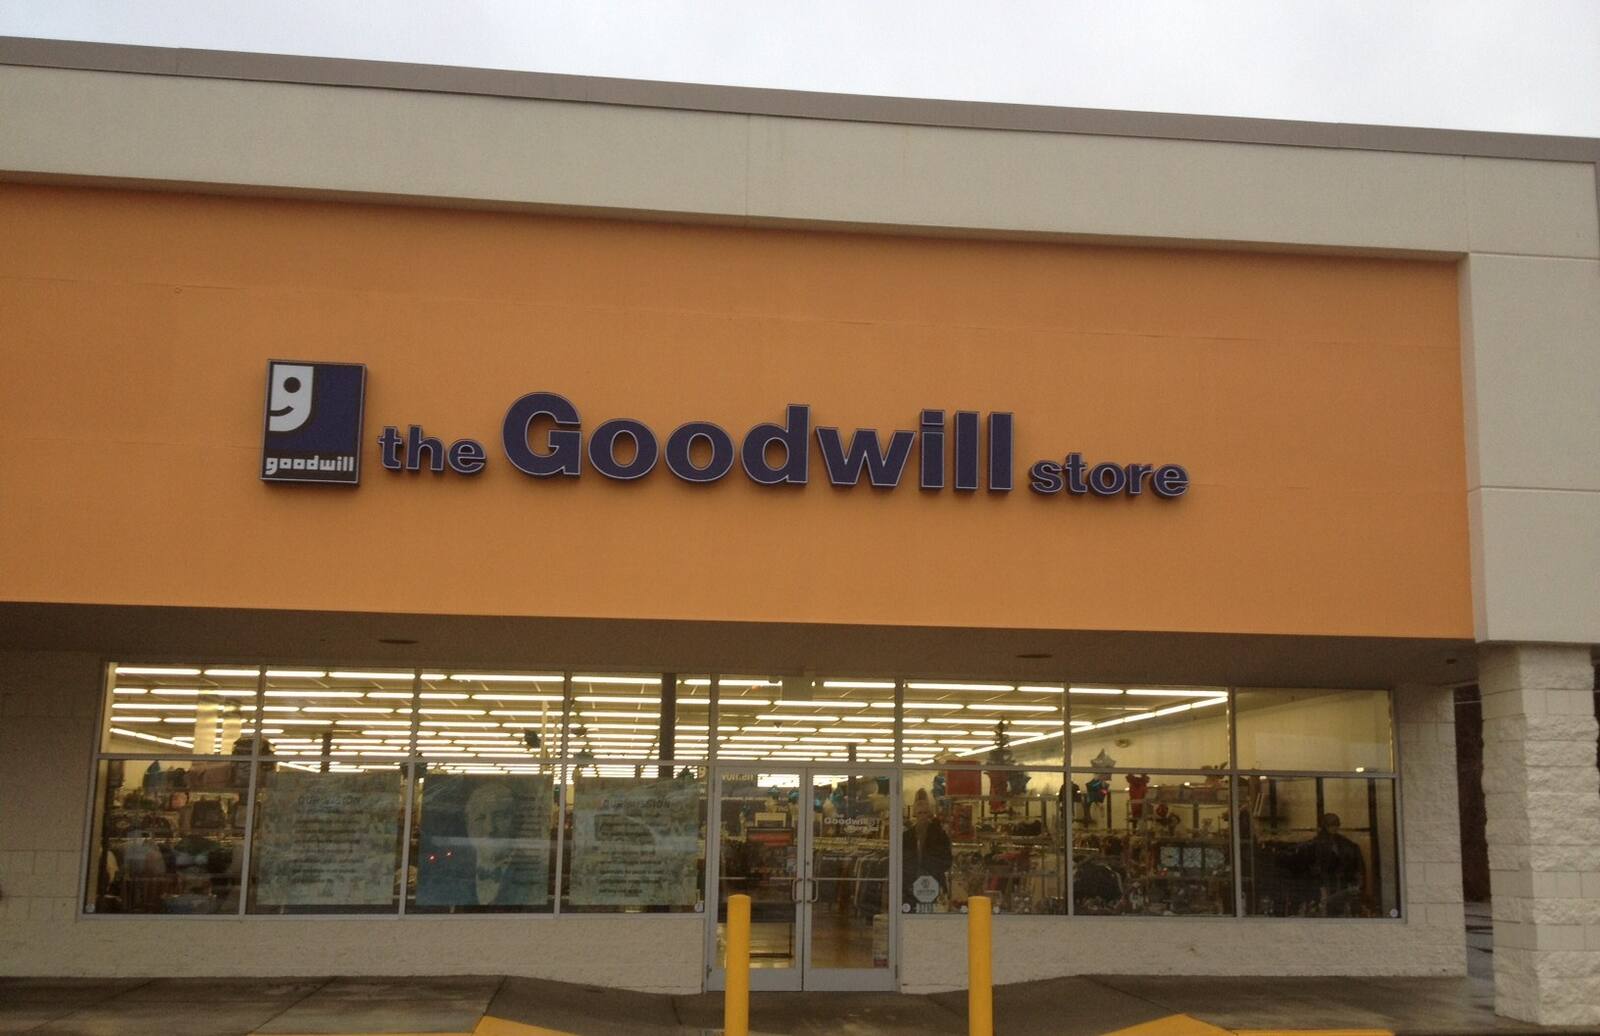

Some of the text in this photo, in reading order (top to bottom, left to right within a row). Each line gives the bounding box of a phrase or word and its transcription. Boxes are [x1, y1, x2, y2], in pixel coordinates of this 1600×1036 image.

[264, 455, 355, 475] goodwill
[377, 391, 1190, 498] the Goodwill store
